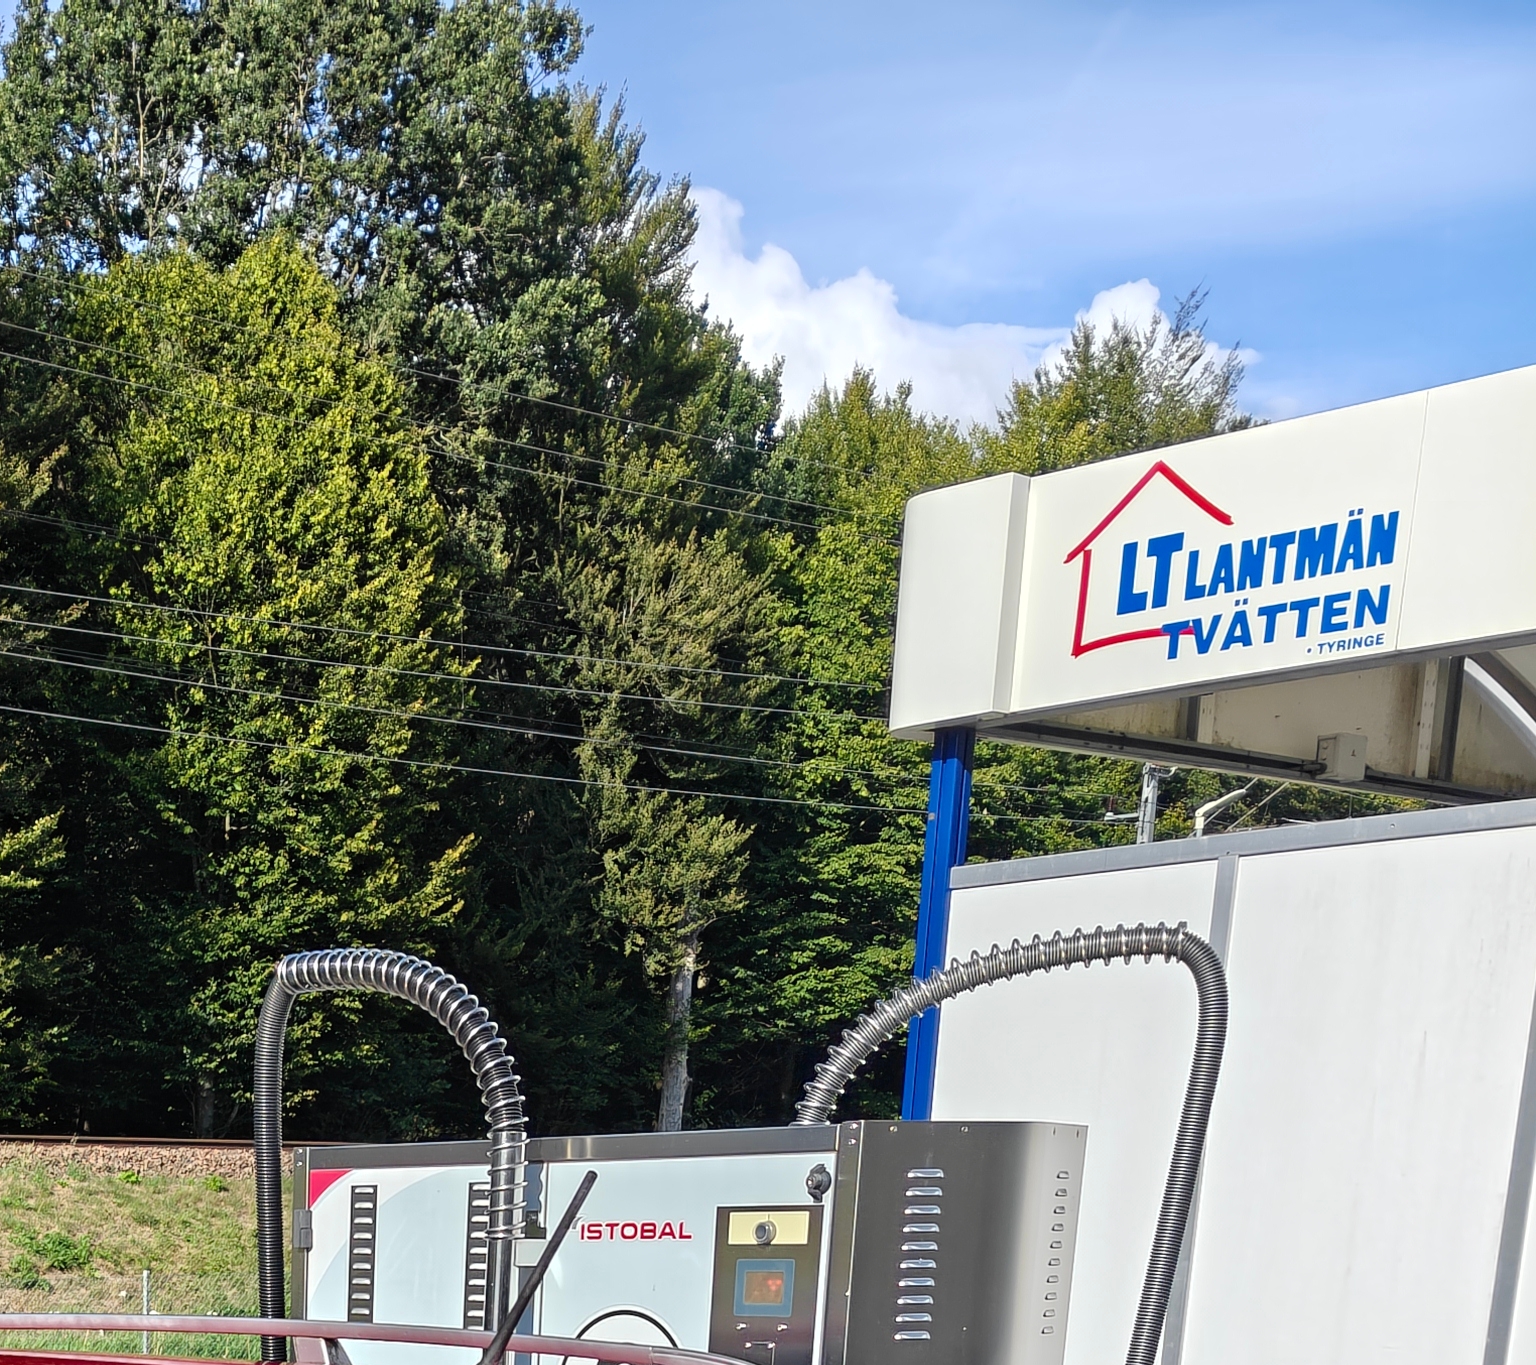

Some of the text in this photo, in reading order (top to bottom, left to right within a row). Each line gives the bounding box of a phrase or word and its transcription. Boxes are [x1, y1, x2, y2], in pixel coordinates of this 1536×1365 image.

[1116, 508, 1400, 616] LT LANTMÄN
[1162, 584, 1391, 660] TVÄTTEN
[1316, 633, 1385, 655] TYRINGE
[580, 1222, 692, 1240] ISTOBAL
